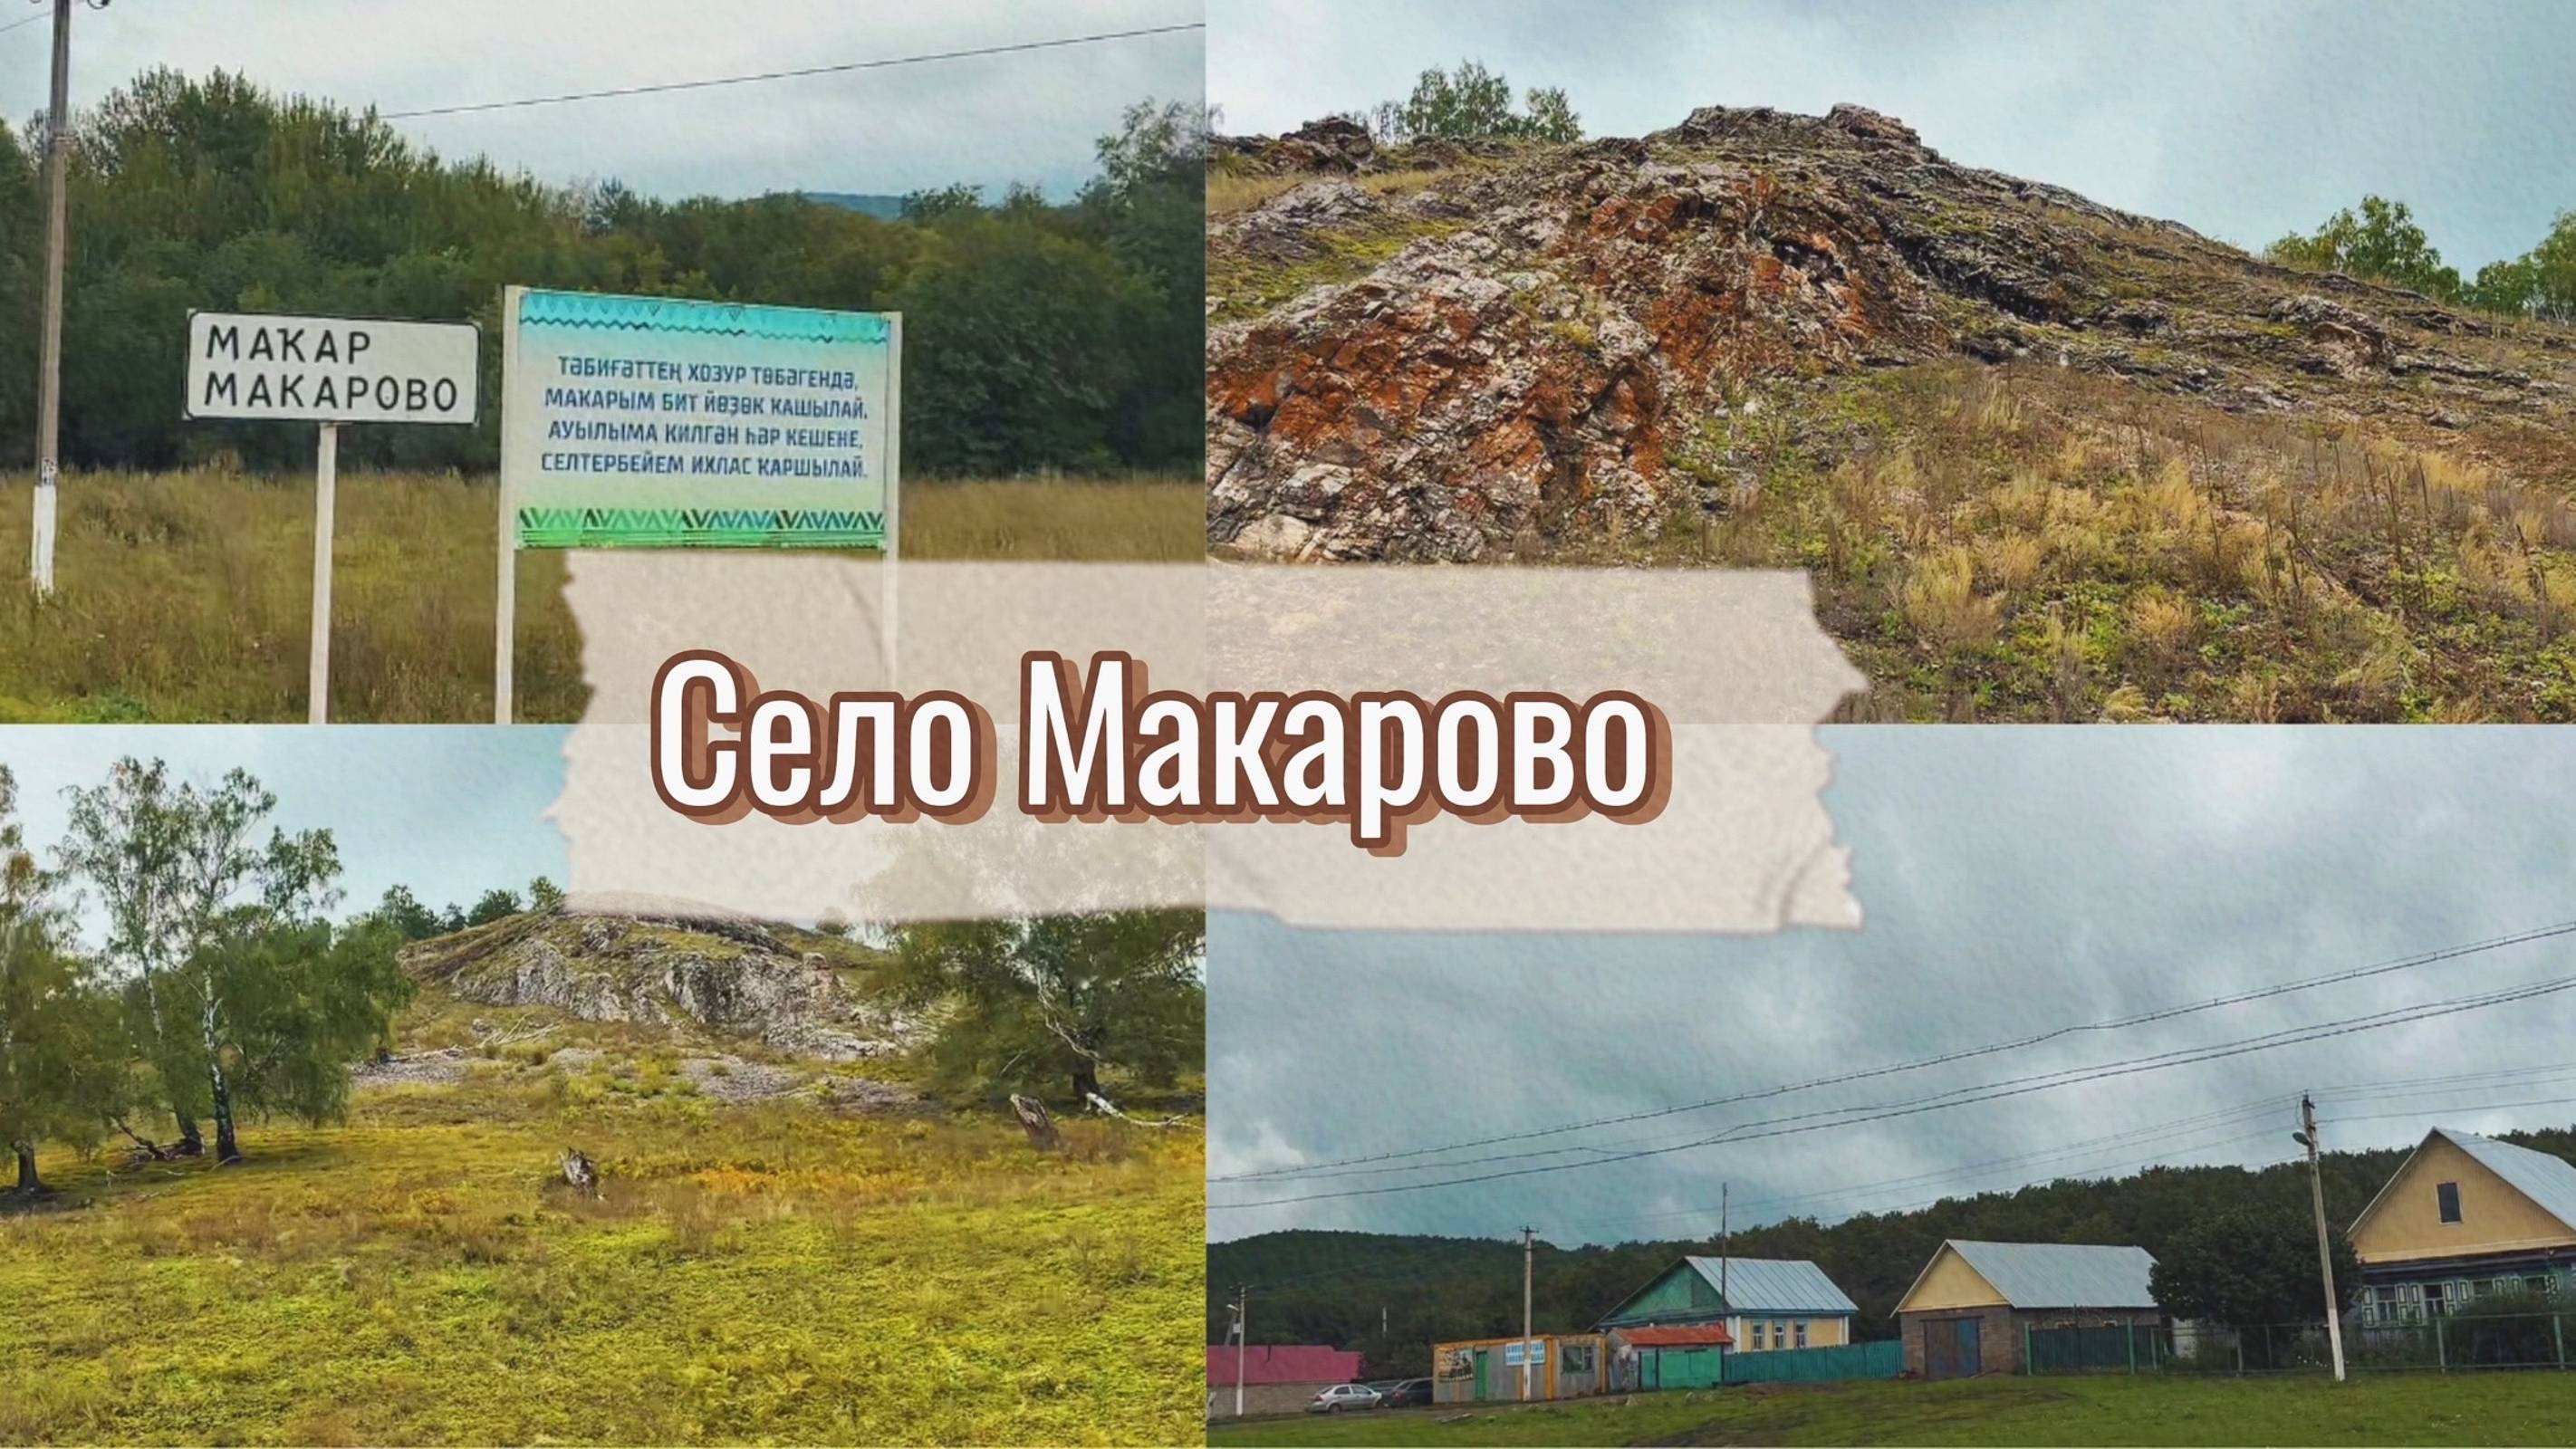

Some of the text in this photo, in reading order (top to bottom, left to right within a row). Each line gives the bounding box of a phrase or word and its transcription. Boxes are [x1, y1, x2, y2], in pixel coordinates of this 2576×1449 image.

[206, 324, 370, 364] МАҠАР
[687, 362, 747, 383] ХОЗУР
[204, 371, 457, 412] МАКАРОВО
[662, 393, 698, 413] БИТ
[548, 420, 658, 442] АУЫЛЫМА
[665, 423, 739, 445] КИЛГӘН
[542, 451, 684, 475] СЕЛТЕРБЕЙЕМ
[691, 456, 752, 476] ИХЛАС
